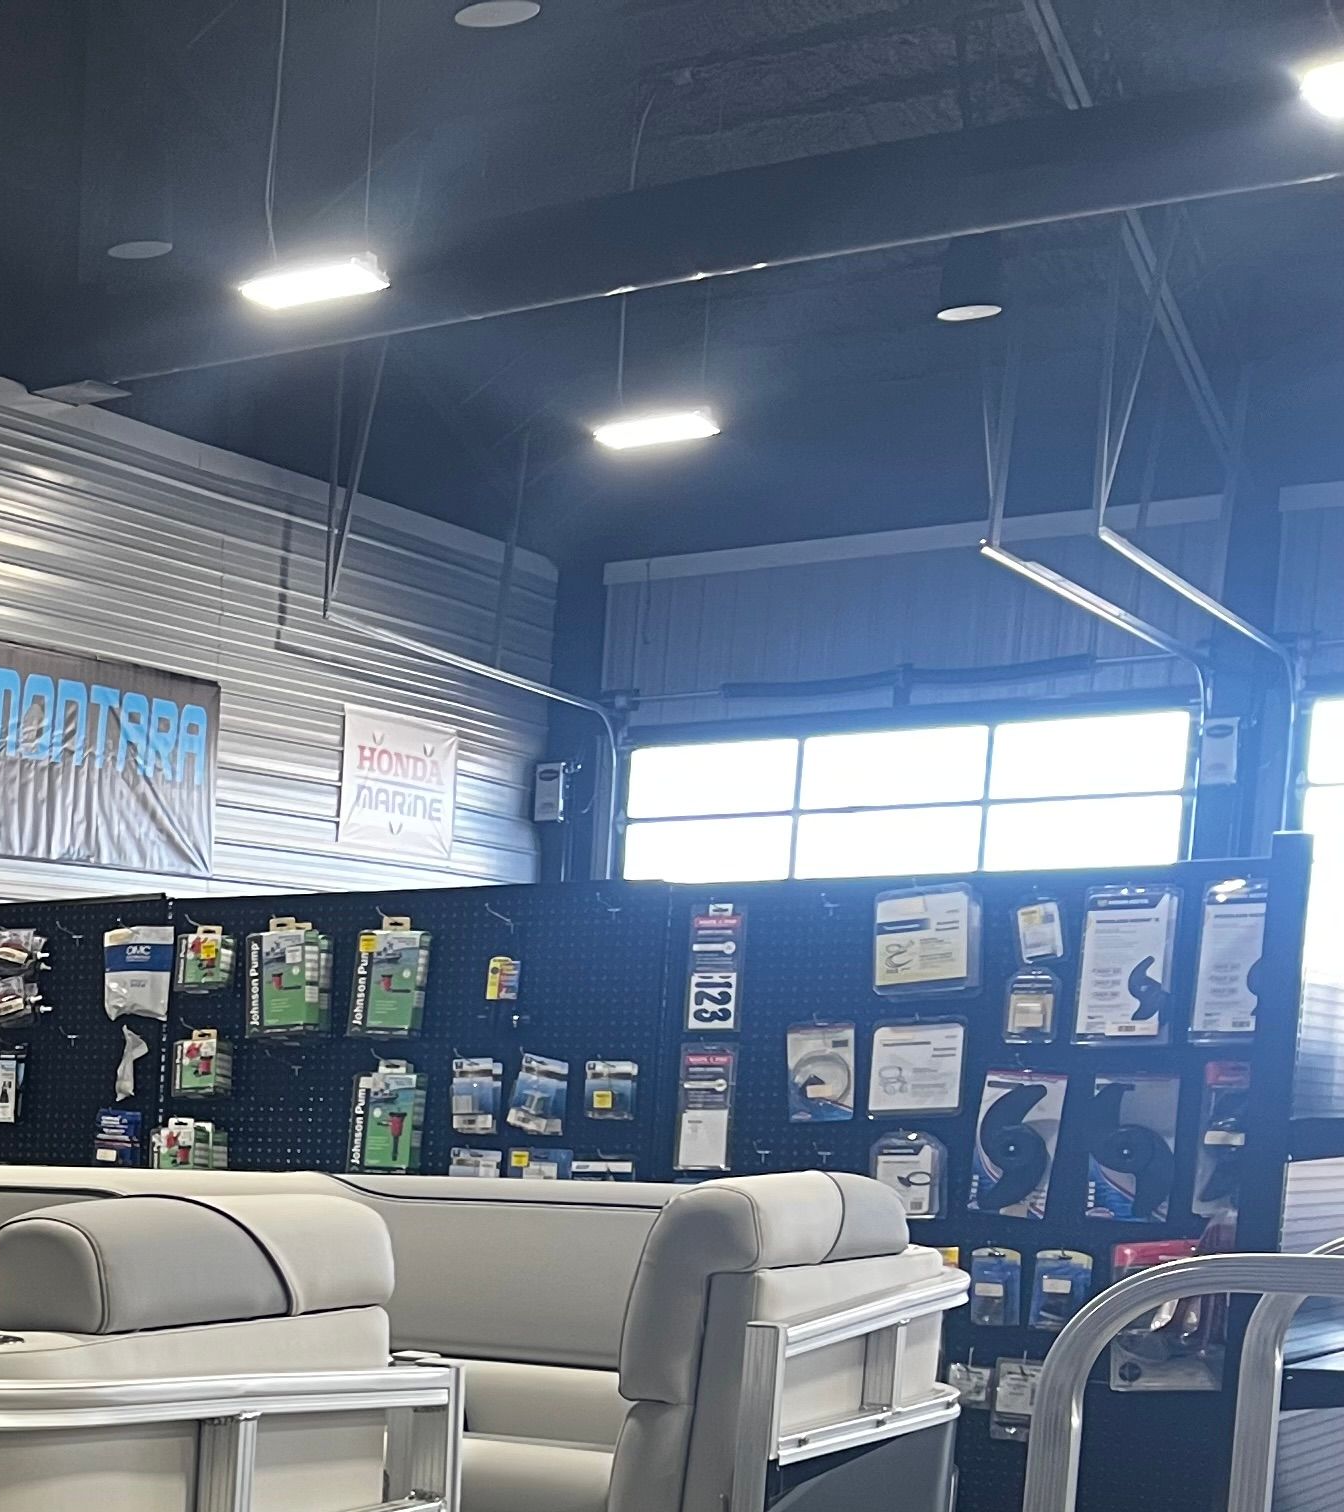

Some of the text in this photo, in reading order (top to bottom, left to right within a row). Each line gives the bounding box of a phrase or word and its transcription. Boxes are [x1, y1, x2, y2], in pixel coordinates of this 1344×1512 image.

[356, 744, 445, 786] HONDA
[249, 941, 261, 1026] Johnson Pump
[352, 976, 367, 1026] Johnson
[351, 1116, 364, 1165] Johnson
